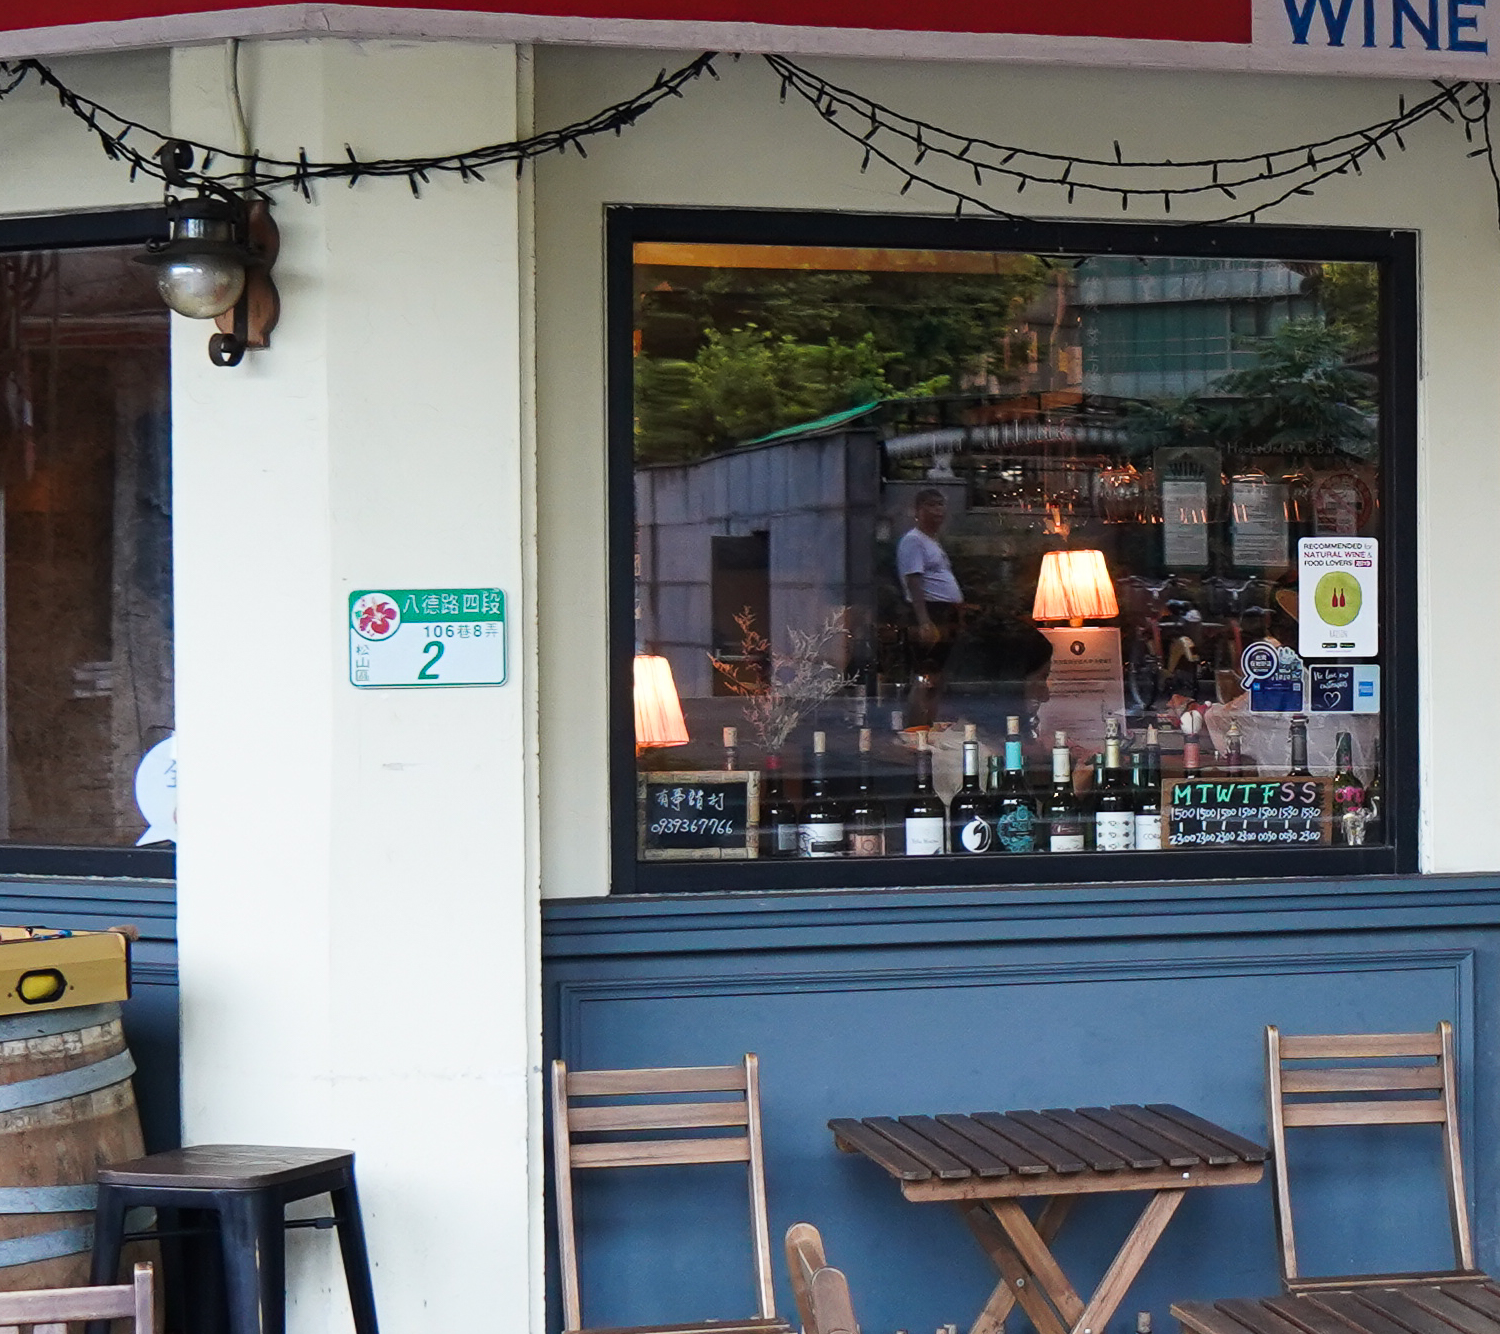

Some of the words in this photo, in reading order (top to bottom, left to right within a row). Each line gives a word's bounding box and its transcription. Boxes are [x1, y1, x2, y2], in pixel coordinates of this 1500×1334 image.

[403, 592, 500, 615] 八德路四段
[356, 644, 370, 681] 松山區
[418, 640, 445, 680] 2
[1174, 784, 1192, 805] M
[1195, 783, 1213, 803] T
[1216, 783, 1235, 803] W
[1237, 783, 1257, 804] T
[1260, 782, 1280, 805] F
[1280, 782, 1295, 802] S
[1300, 782, 1316, 803] S
[651, 818, 733, 834] 0939367766
